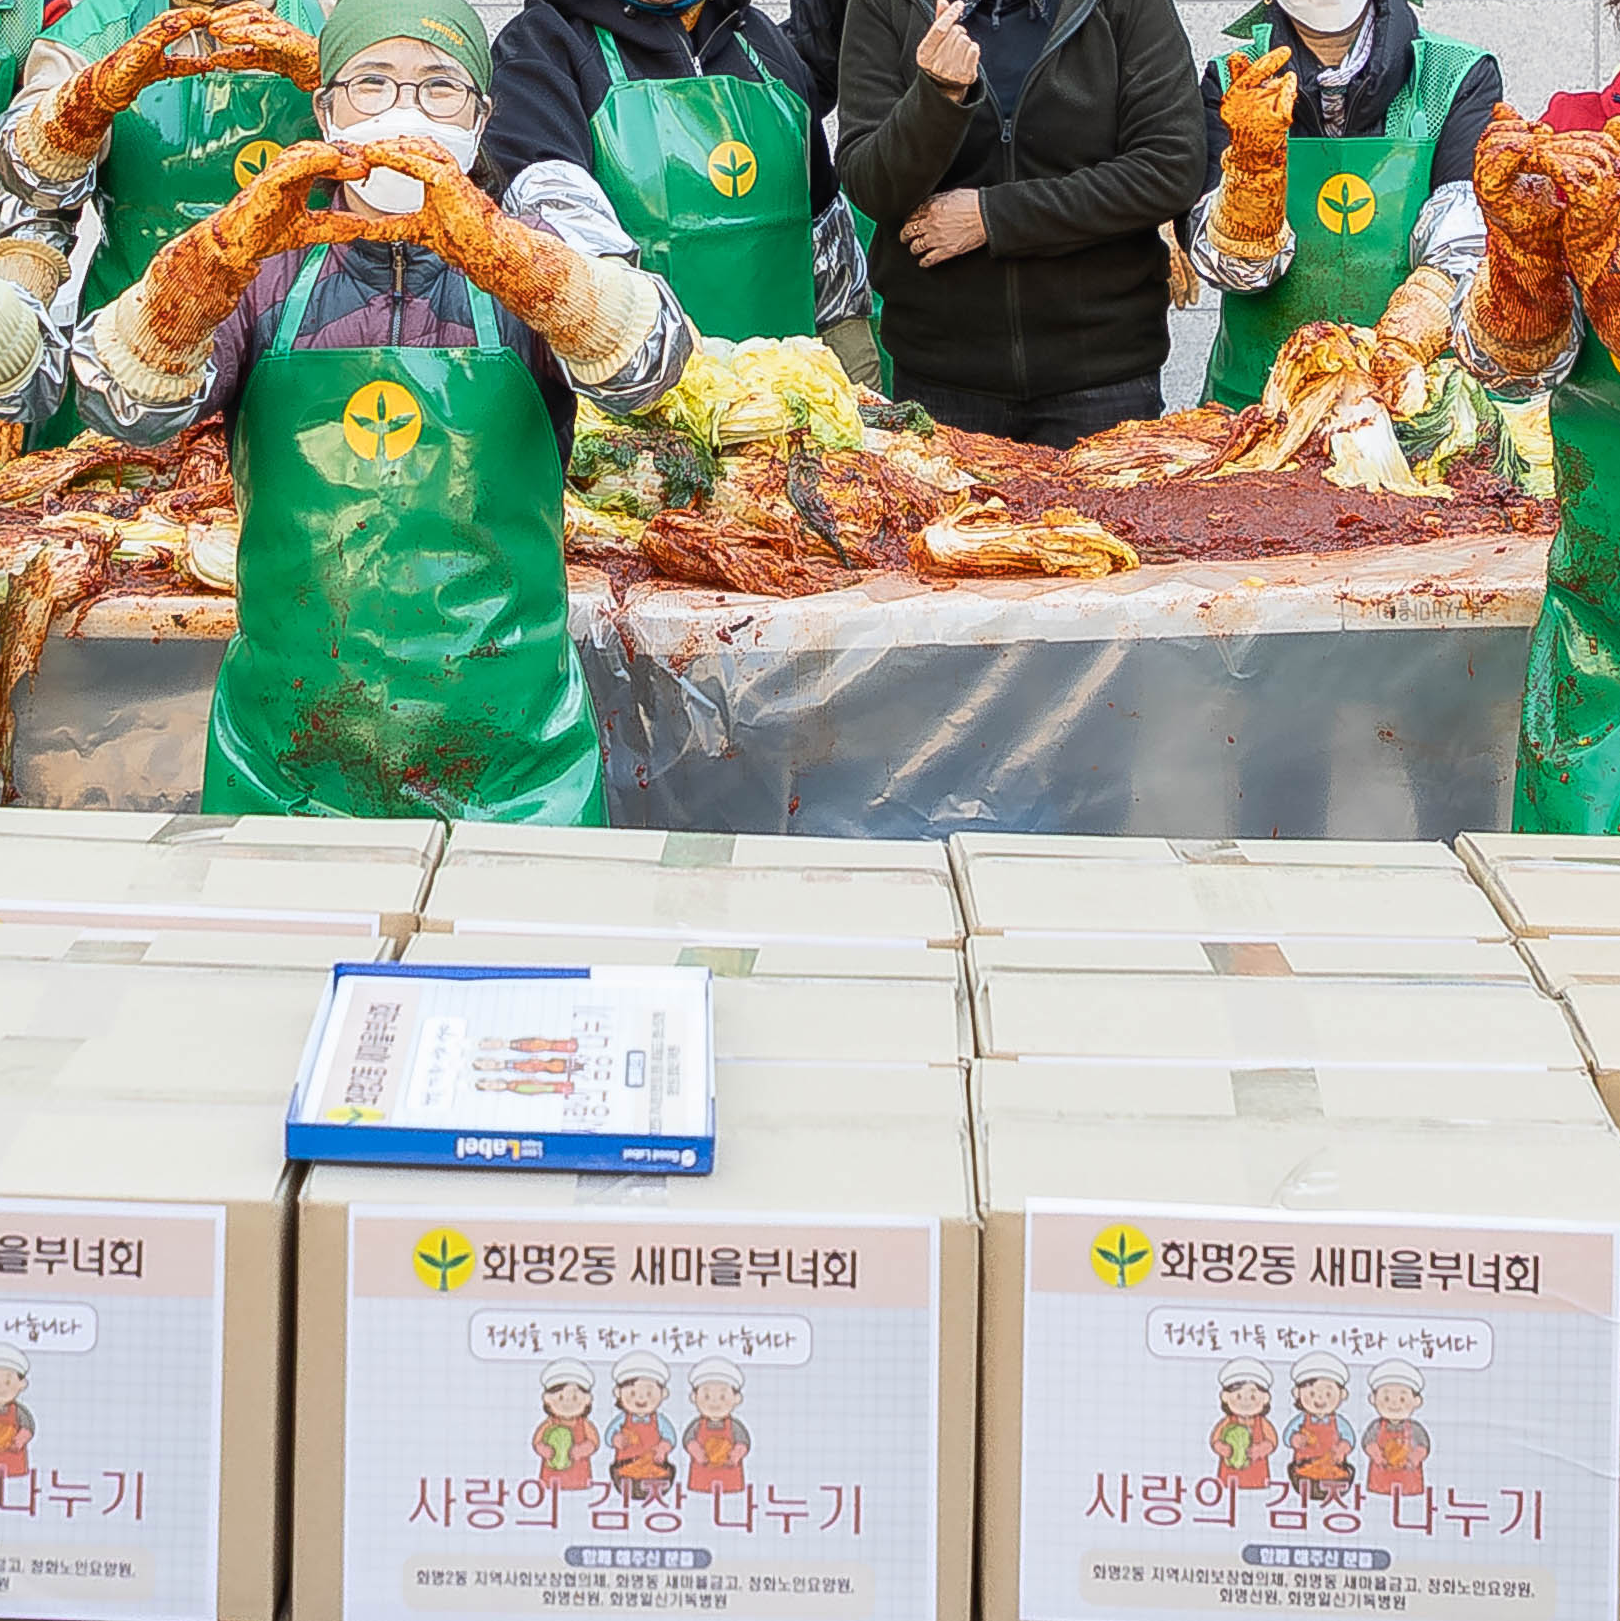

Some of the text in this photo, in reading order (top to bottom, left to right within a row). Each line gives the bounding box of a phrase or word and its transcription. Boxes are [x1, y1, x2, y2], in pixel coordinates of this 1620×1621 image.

[481, 1242, 857, 1289] 화명2동 새마을부녀회
[1159, 1241, 1540, 1294] 화명2동 새마을부녀회
[487, 1324, 796, 1355] 정성을 가득 담아 이웃과 나눕니다
[1164, 1321, 1477, 1357] 정성을 가득 담아 이웃과 나눕니다
[409, 1477, 861, 1536] 사랑의 김장 나누기
[1085, 1473, 1543, 1540] 사랑의 김장 나누기
